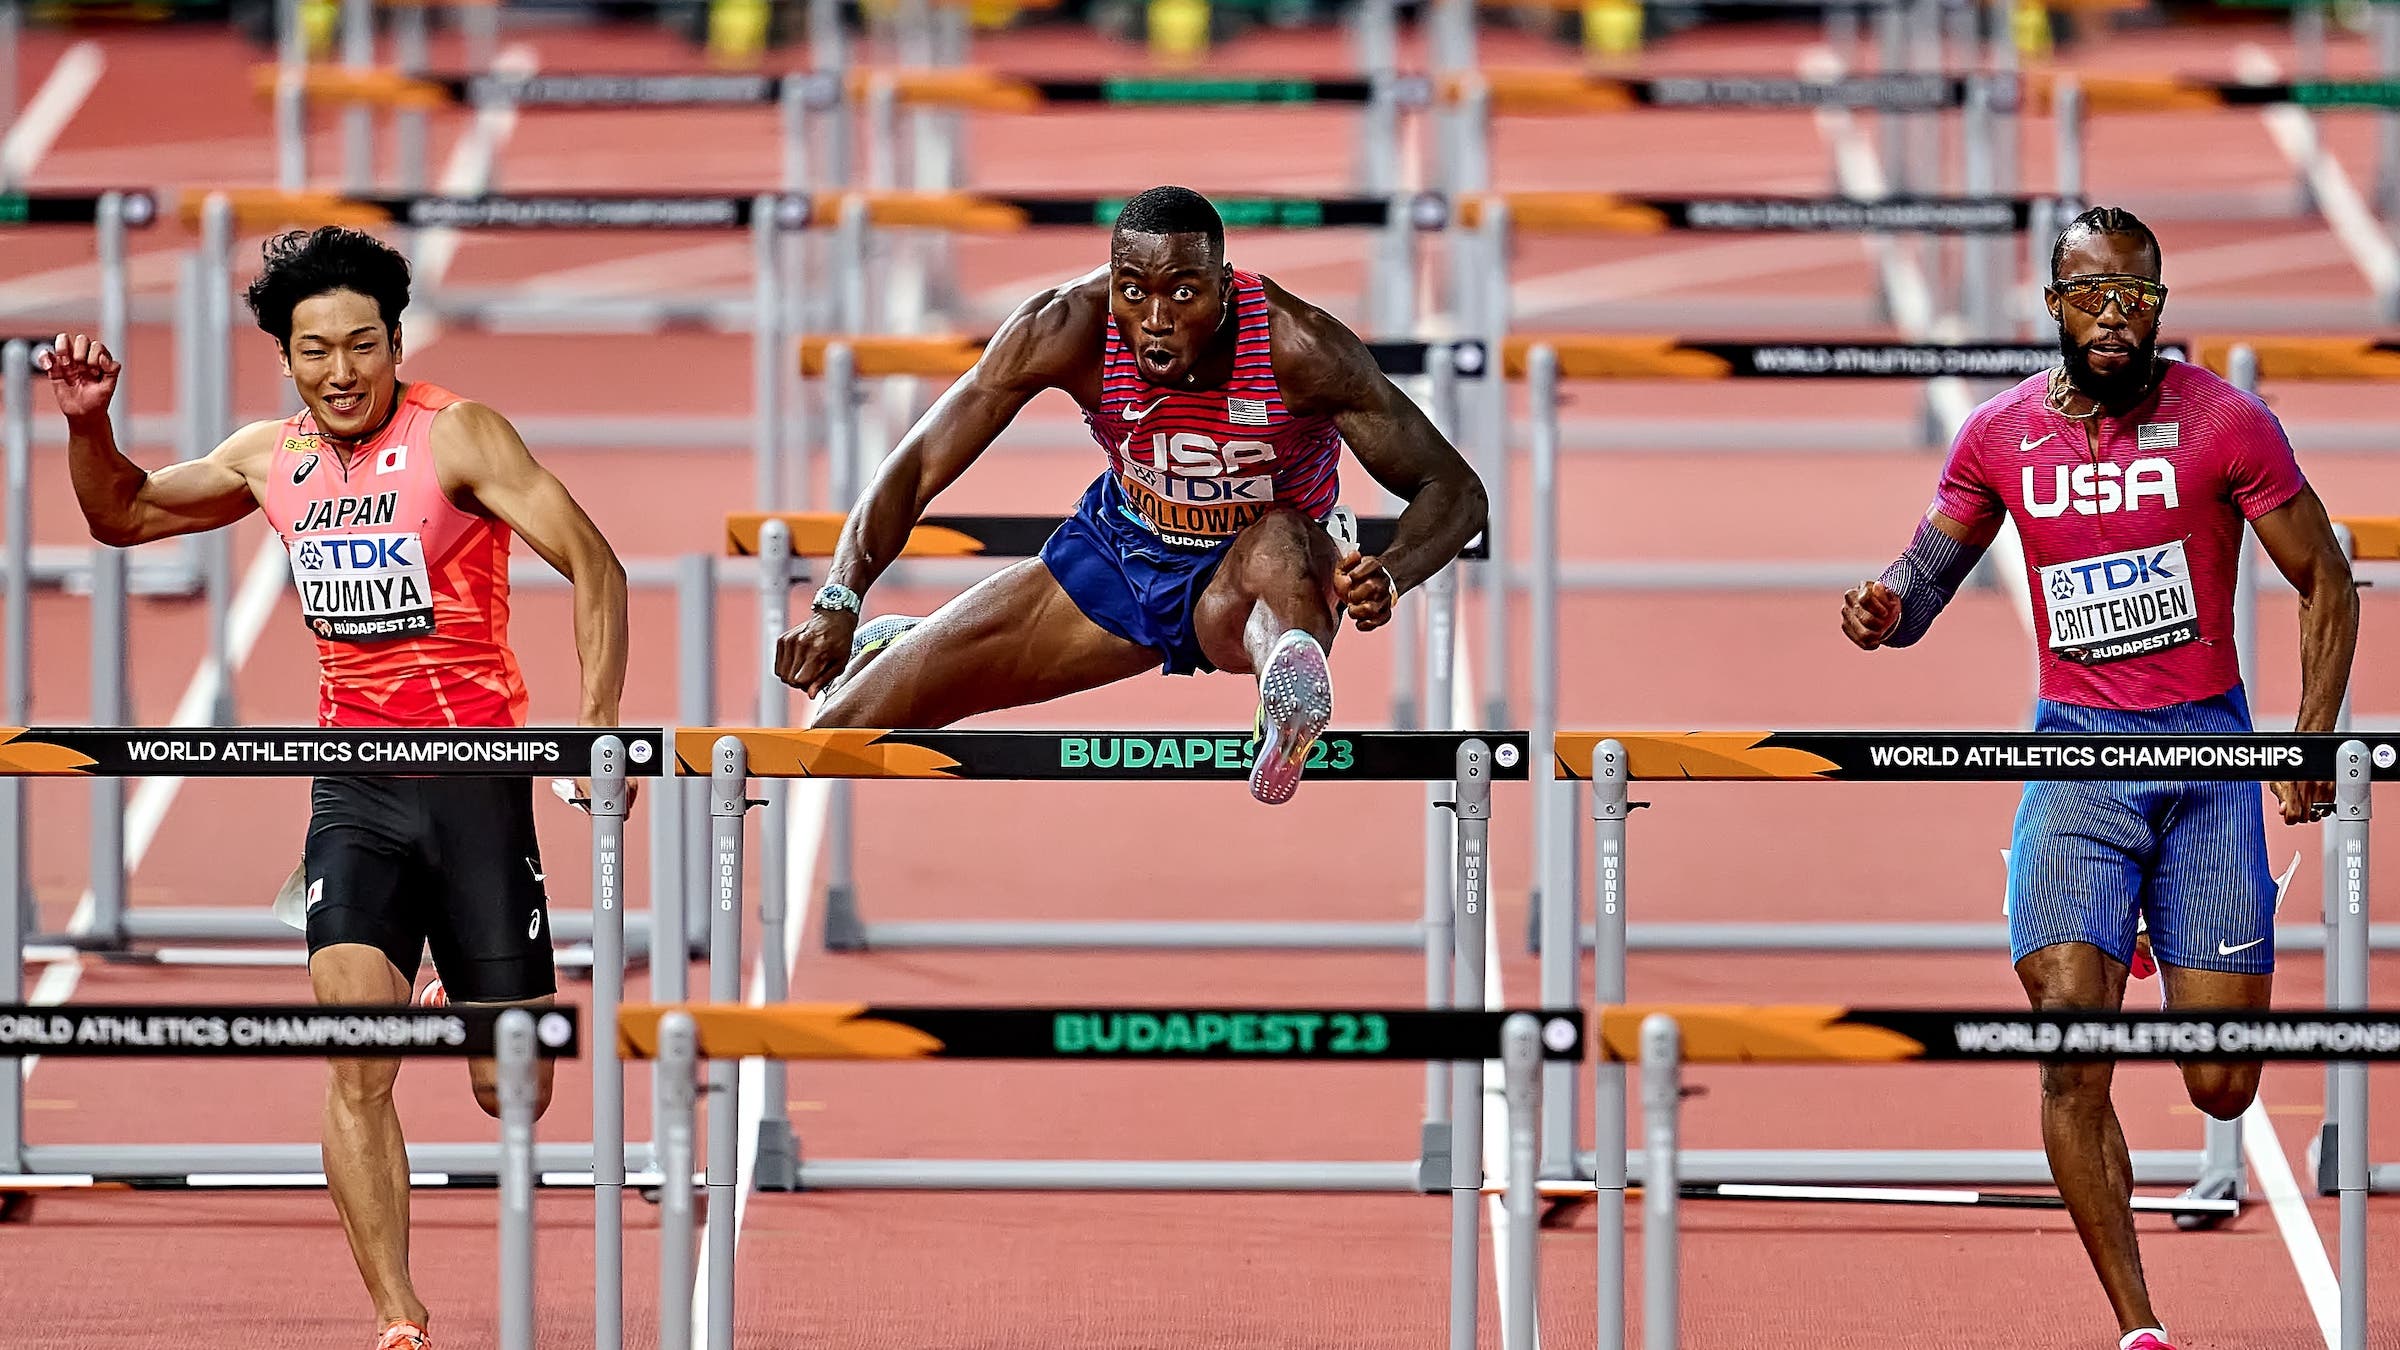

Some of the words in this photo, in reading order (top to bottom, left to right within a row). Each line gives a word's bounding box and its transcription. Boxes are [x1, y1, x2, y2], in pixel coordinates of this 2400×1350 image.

[1165, 476, 1259, 501] TDK
[2022, 458, 2179, 518] USA
[294, 491, 398, 533] JAPAN
[1128, 484, 1265, 533] HOLLOWAY
[322, 538, 413, 569] TDK
[2071, 550, 2175, 594] TDK
[303, 576, 422, 612] IZUMIYA
[334, 617, 406, 635] BUDAPEST
[407, 616, 427, 630] 23
[2055, 585, 2188, 642] CRITTENDEN
[2092, 632, 2172, 659] BUDAPEST
[2172, 628, 2191, 643] 23
[127, 741, 216, 761] WORLD
[221, 741, 352, 762] ATHLETICS
[358, 741, 560, 762] CHAMPIONSHIPS
[1061, 739, 1255, 769] BUDAPES
[1305, 739, 1354, 769] 23
[1870, 746, 1959, 767] WORLD
[1965, 746, 2096, 767] ATHLETICS
[2101, 746, 2304, 767] CHAMPIONSHIPS
[600, 852, 615, 910] MONDO
[720, 853, 735, 911] MONDO
[1465, 856, 1480, 914] MONDO
[1603, 856, 1618, 915] MONDO
[2346, 856, 2361, 914] MONDO
[0, 1014, 74, 1044] ORLD
[76, 1015, 229, 1046] ATHLETICS
[230, 1016, 466, 1046] CHAMPIONSHIPS
[1054, 1014, 1323, 1052] BUDAPEST
[1329, 1014, 1389, 1052] 23
[1955, 1022, 2062, 1052] WORLD
[2063, 1022, 2216, 1052] ATHLETICS
[2218, 1022, 2400, 1052] CHAMPIONS
